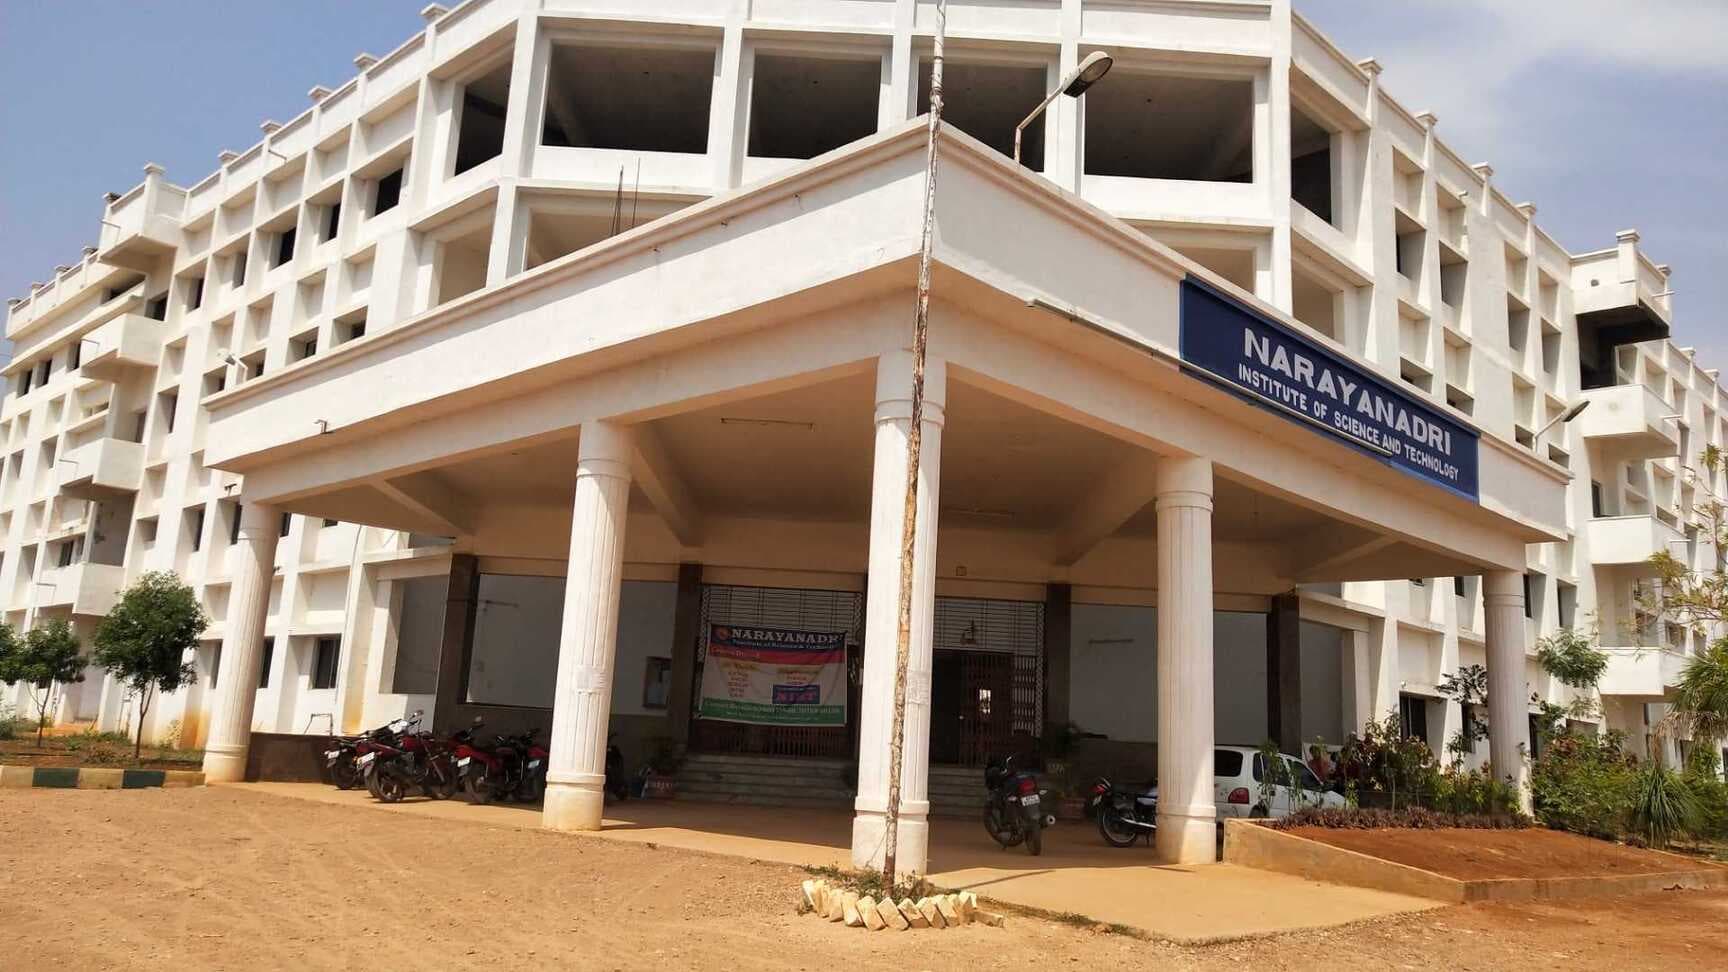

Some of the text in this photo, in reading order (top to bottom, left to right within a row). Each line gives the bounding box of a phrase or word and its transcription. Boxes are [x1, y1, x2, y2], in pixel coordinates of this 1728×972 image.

[1238, 363, 1459, 481] INSTITUTE OF SCIENCE AND TECHNOLOGY
[1244, 327, 1451, 455] NARAYANADRI
